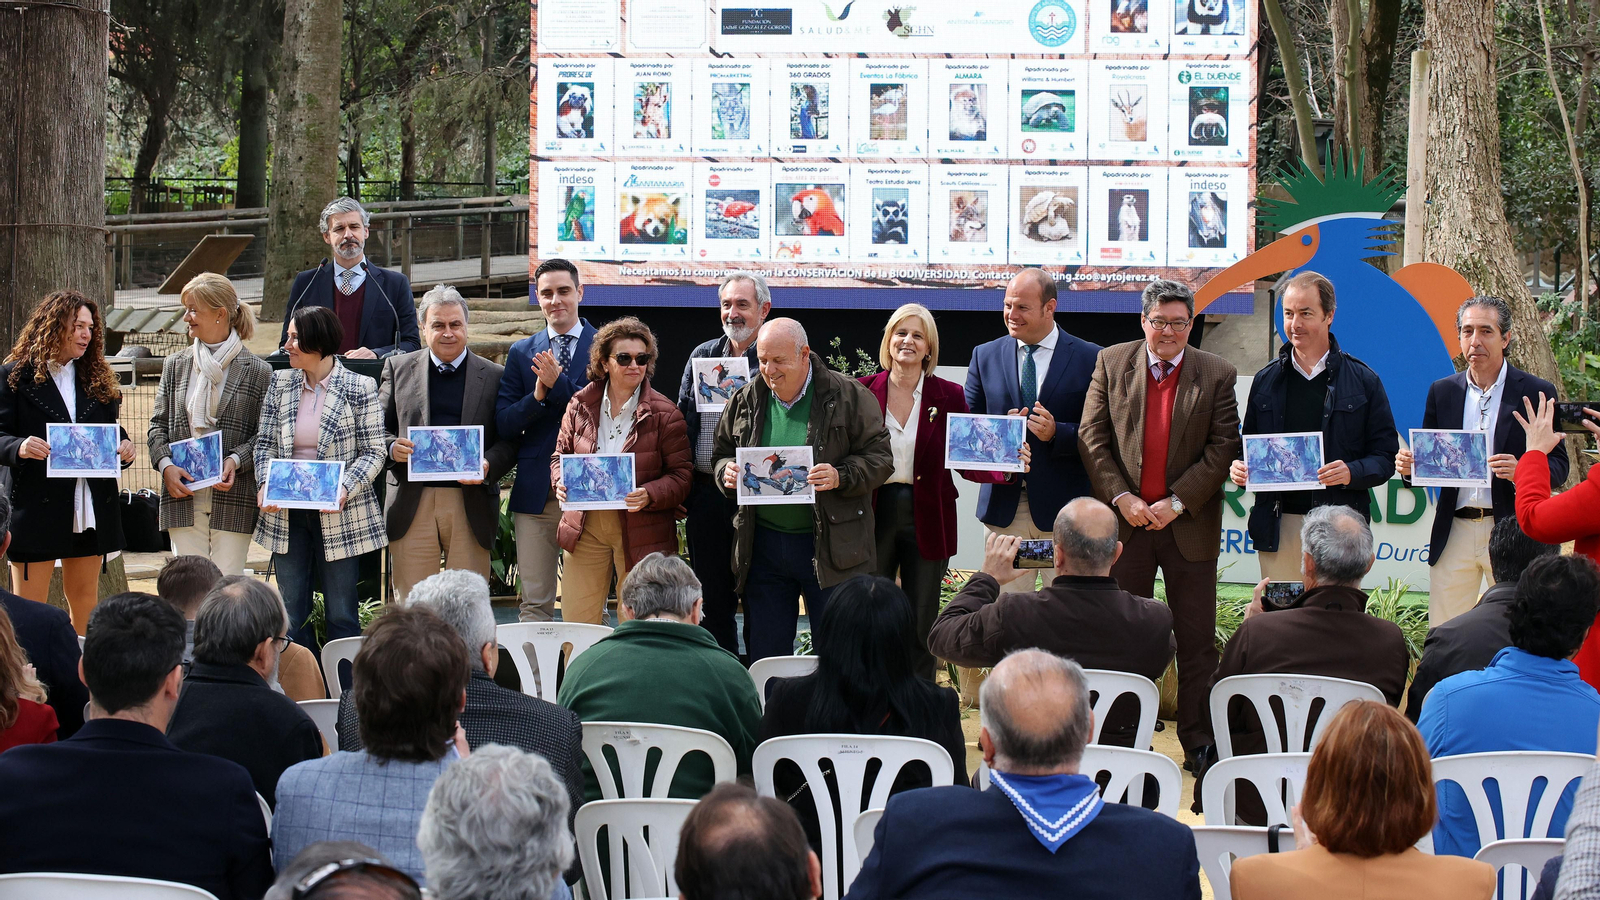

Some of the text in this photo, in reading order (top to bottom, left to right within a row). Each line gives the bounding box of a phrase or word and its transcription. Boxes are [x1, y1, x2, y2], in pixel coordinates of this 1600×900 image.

[1102, 35, 1120, 46] rbg
[1194, 72, 1241, 80] EL DUENDE
[559, 174, 594, 184] indeso
[1190, 179, 1226, 190] indeso
[619, 266, 679, 277] Necesitamos
[681, 267, 692, 277] tu
[775, 268, 783, 278] la
[865, 268, 877, 278] de
[878, 268, 887, 278] la
[1376, 542, 1431, 563] Durá
